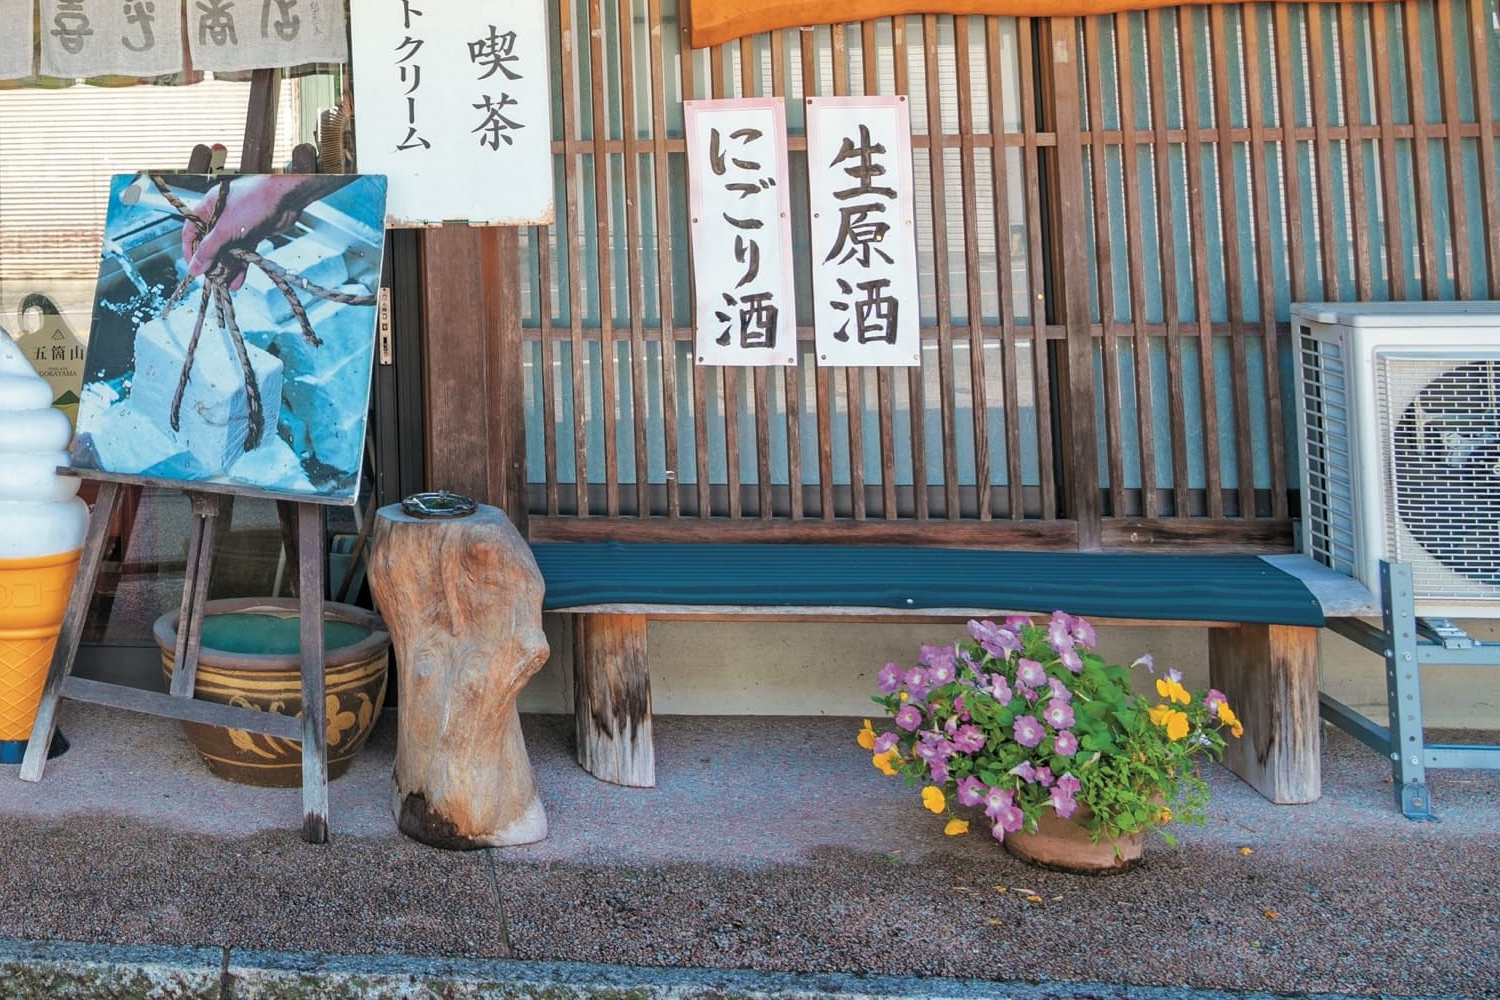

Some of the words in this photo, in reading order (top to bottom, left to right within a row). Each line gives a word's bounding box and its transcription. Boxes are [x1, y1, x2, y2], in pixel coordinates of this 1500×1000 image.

[709, 127, 776, 350] にごり酒
[823, 123, 900, 346] 生原酒
[34, 345, 84, 361] 五箇山
